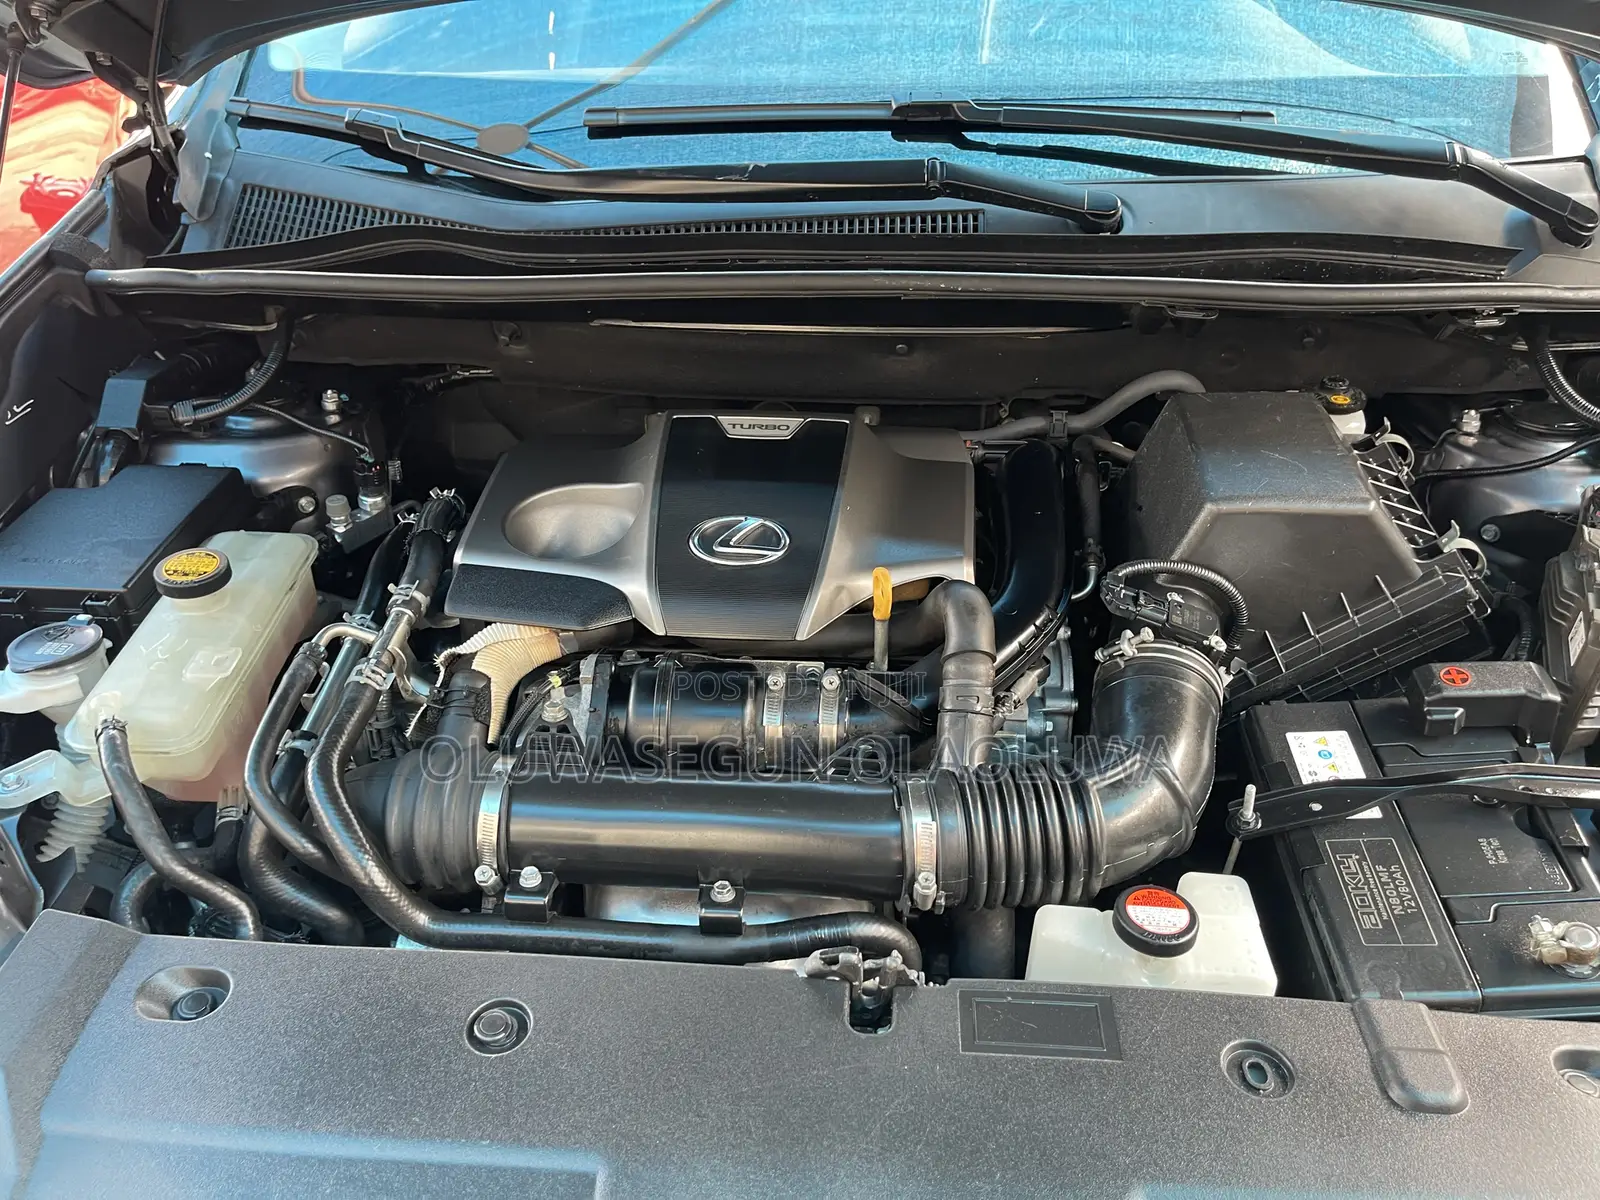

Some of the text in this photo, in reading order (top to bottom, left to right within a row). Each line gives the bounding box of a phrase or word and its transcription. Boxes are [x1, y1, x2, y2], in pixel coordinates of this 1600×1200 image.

[728, 423, 791, 431] TURBO
[1375, 864, 1405, 915] N80LMF
[1389, 864, 1418, 914] 12V80Ah
